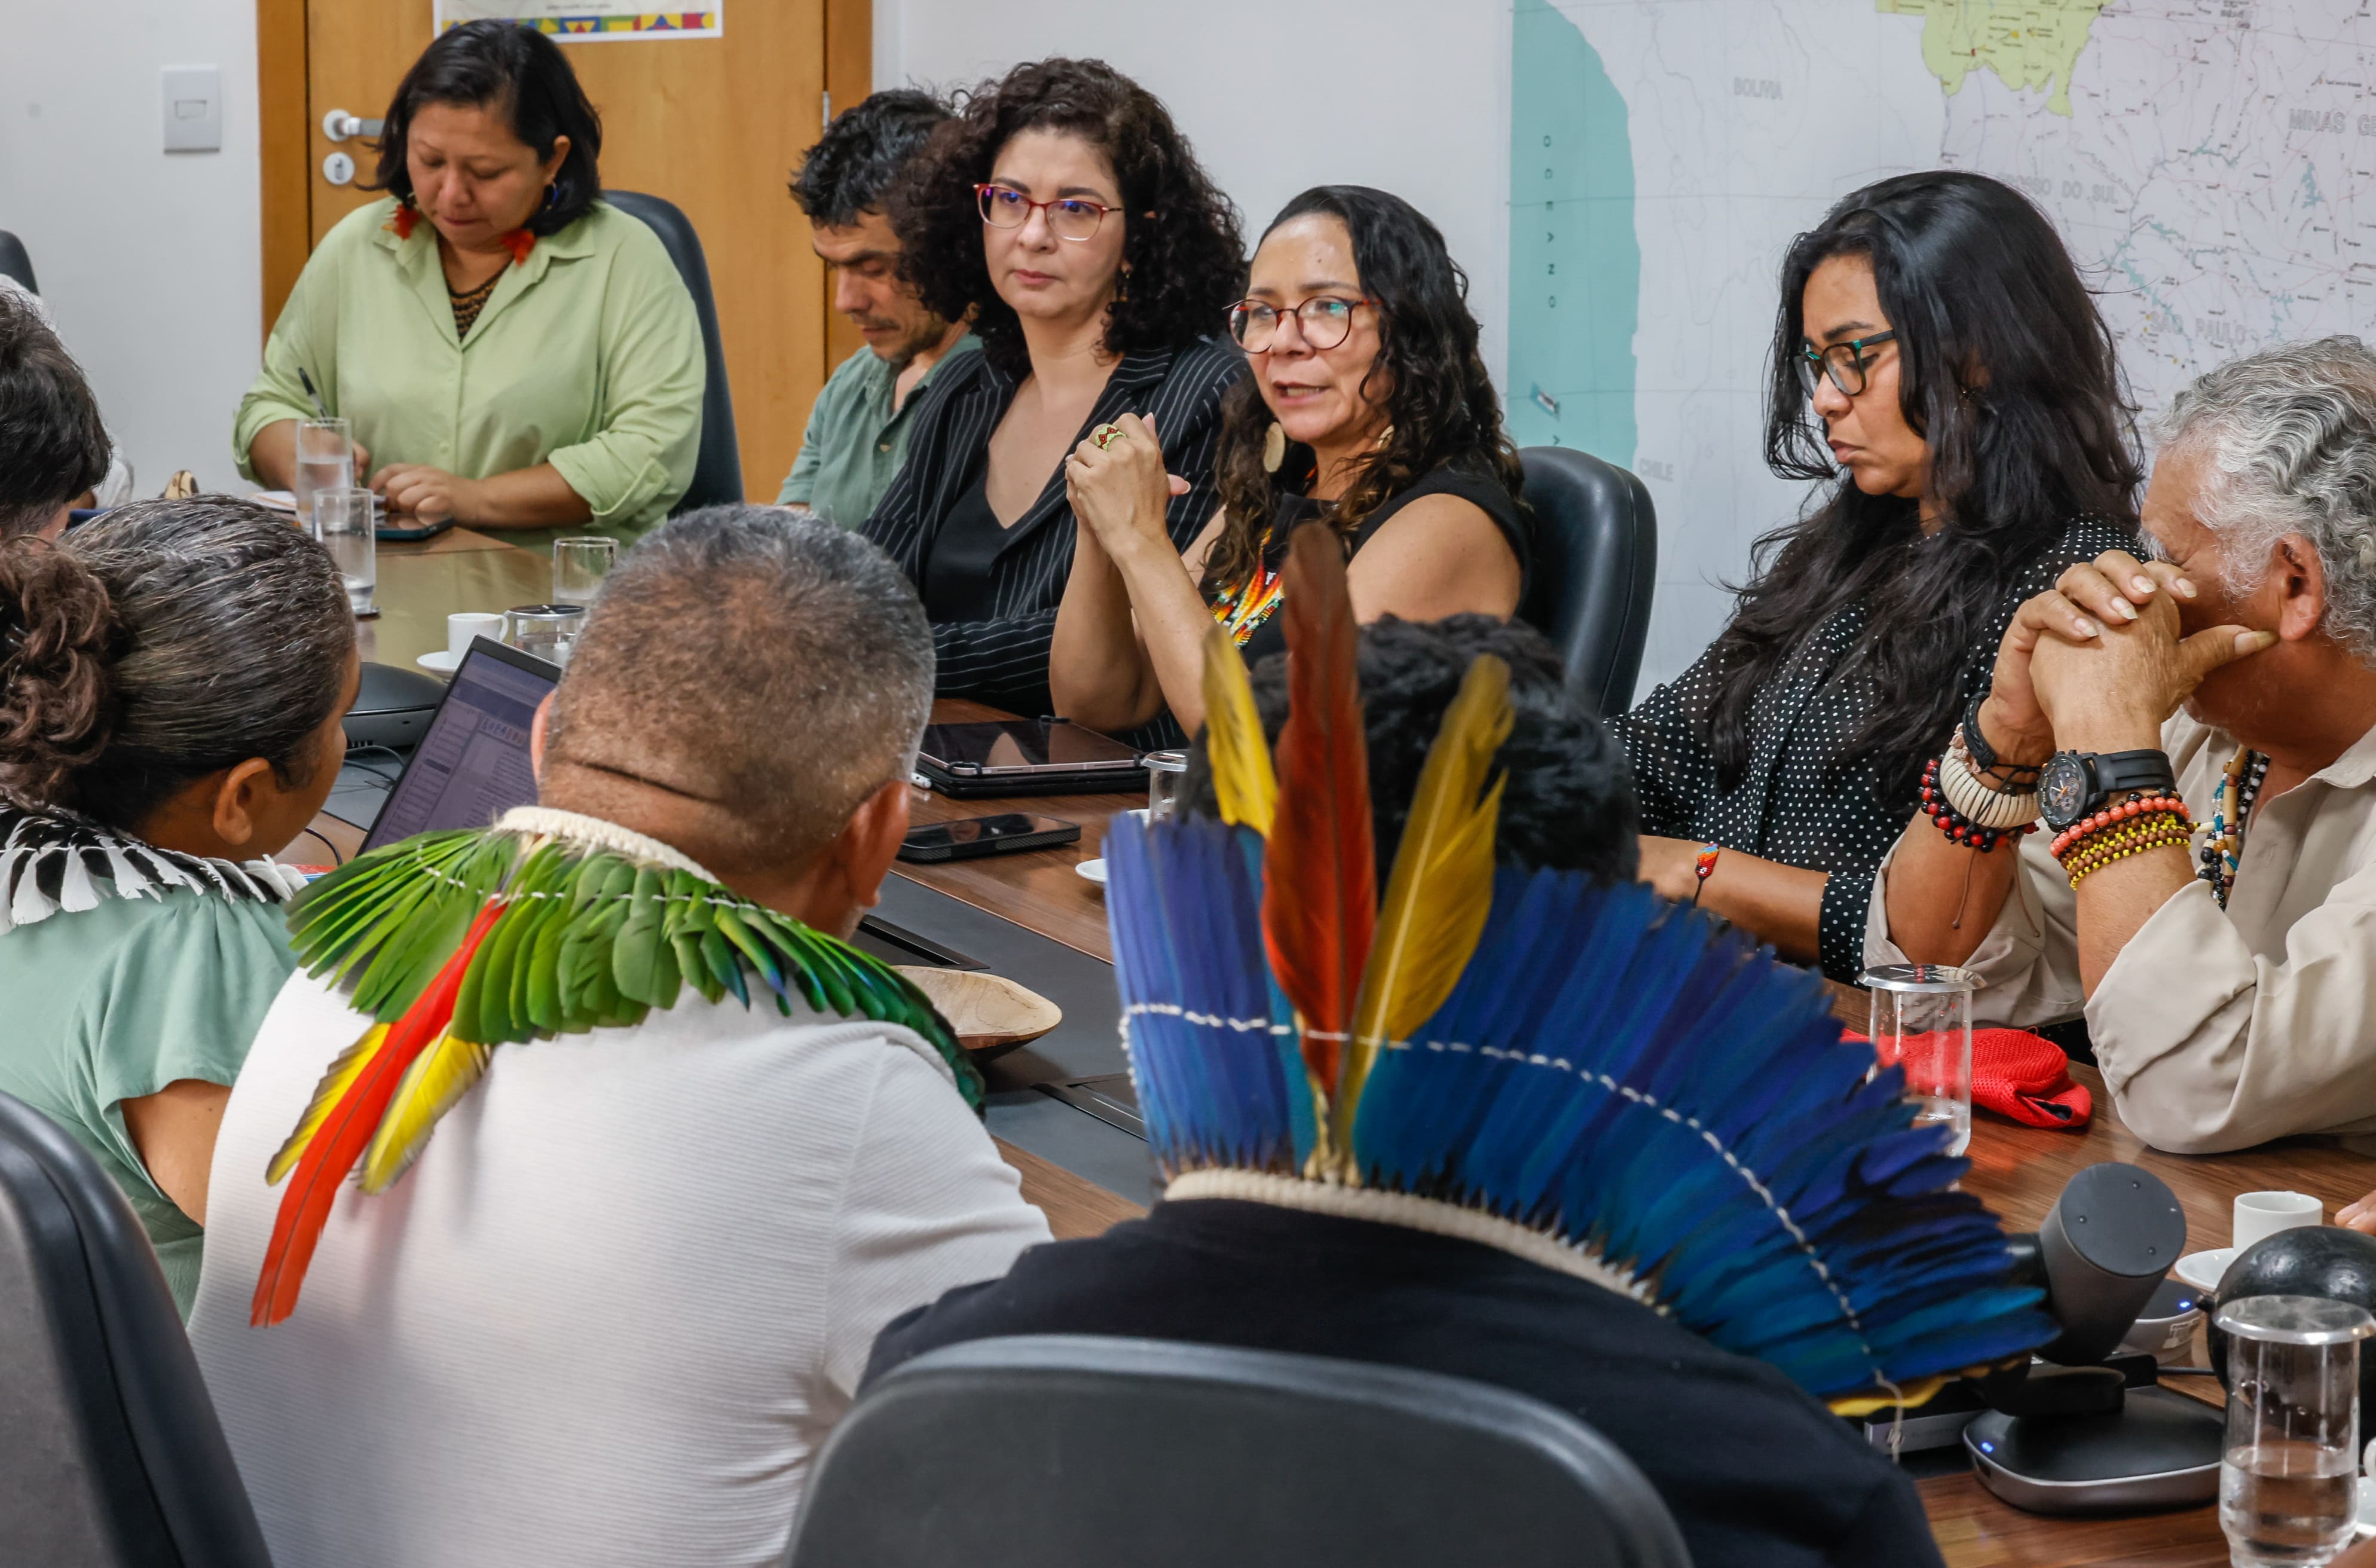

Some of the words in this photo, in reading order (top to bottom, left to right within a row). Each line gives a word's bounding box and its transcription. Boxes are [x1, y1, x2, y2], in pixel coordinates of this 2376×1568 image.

[2289, 109, 2344, 134] MINAS
[2062, 181, 2083, 200] DO
[2093, 184, 2118, 204] SUL
[2195, 317, 2246, 346] PAULO
